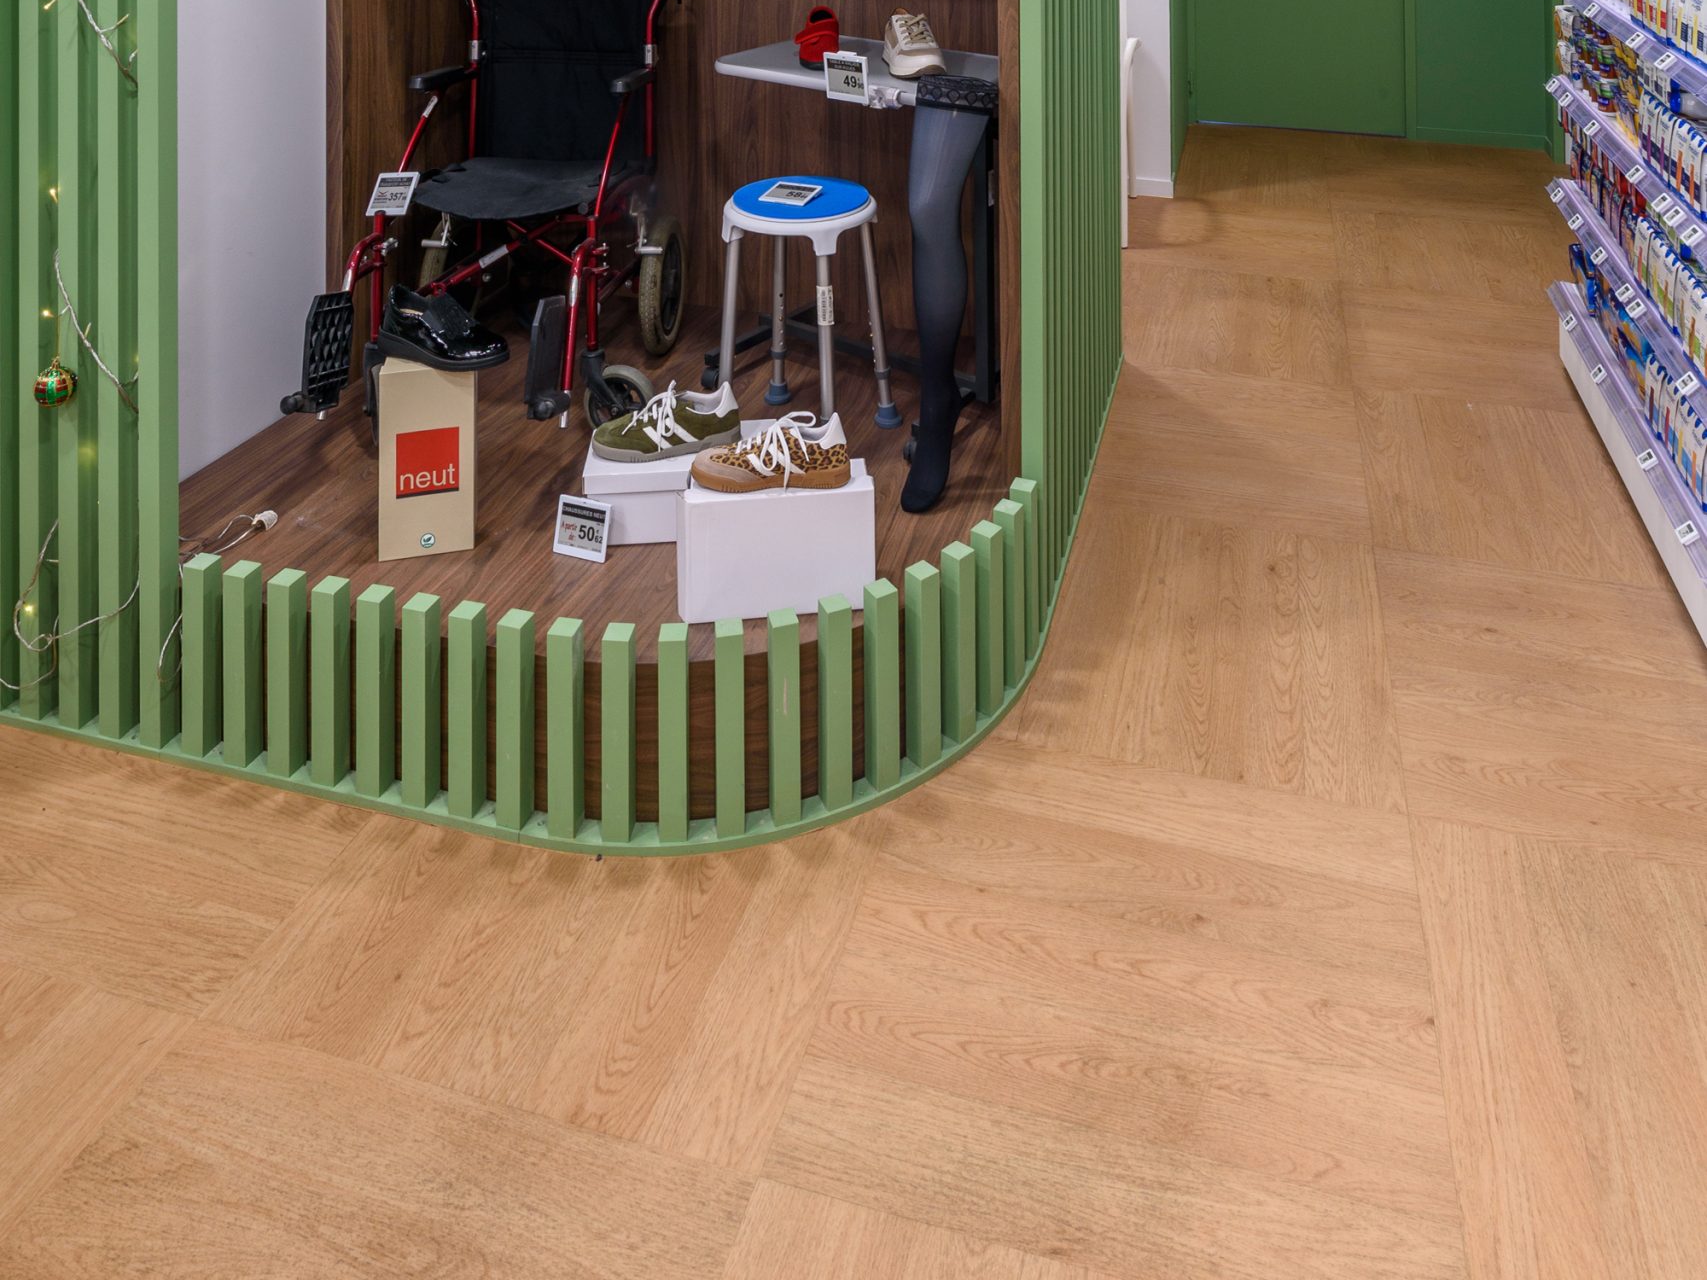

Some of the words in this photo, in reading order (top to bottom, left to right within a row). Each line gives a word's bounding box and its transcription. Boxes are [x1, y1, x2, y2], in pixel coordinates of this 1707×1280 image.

[843, 75, 857, 88] 49
[400, 463, 456, 491] neut
[578, 524, 595, 542] 50
